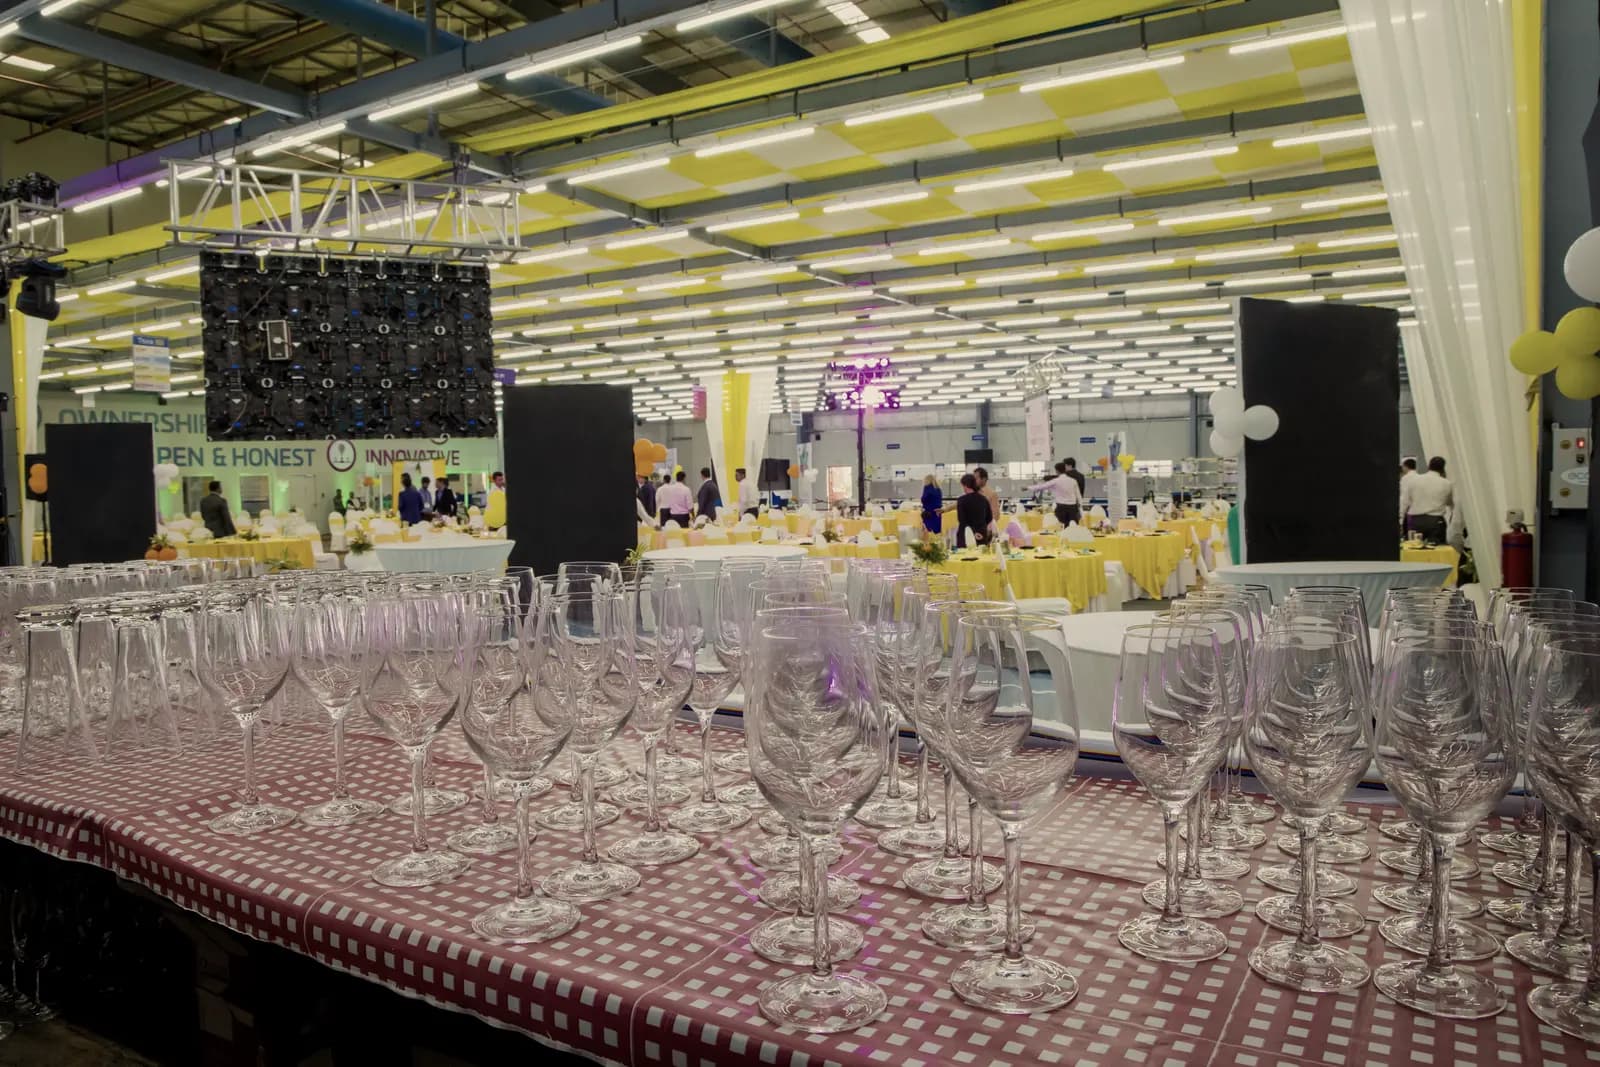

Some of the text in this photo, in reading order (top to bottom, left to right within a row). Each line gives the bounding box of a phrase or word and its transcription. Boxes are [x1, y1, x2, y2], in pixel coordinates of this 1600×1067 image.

[157, 447, 316, 467] PEN & HONEST
[365, 449, 460, 466] INNOVATIVE
